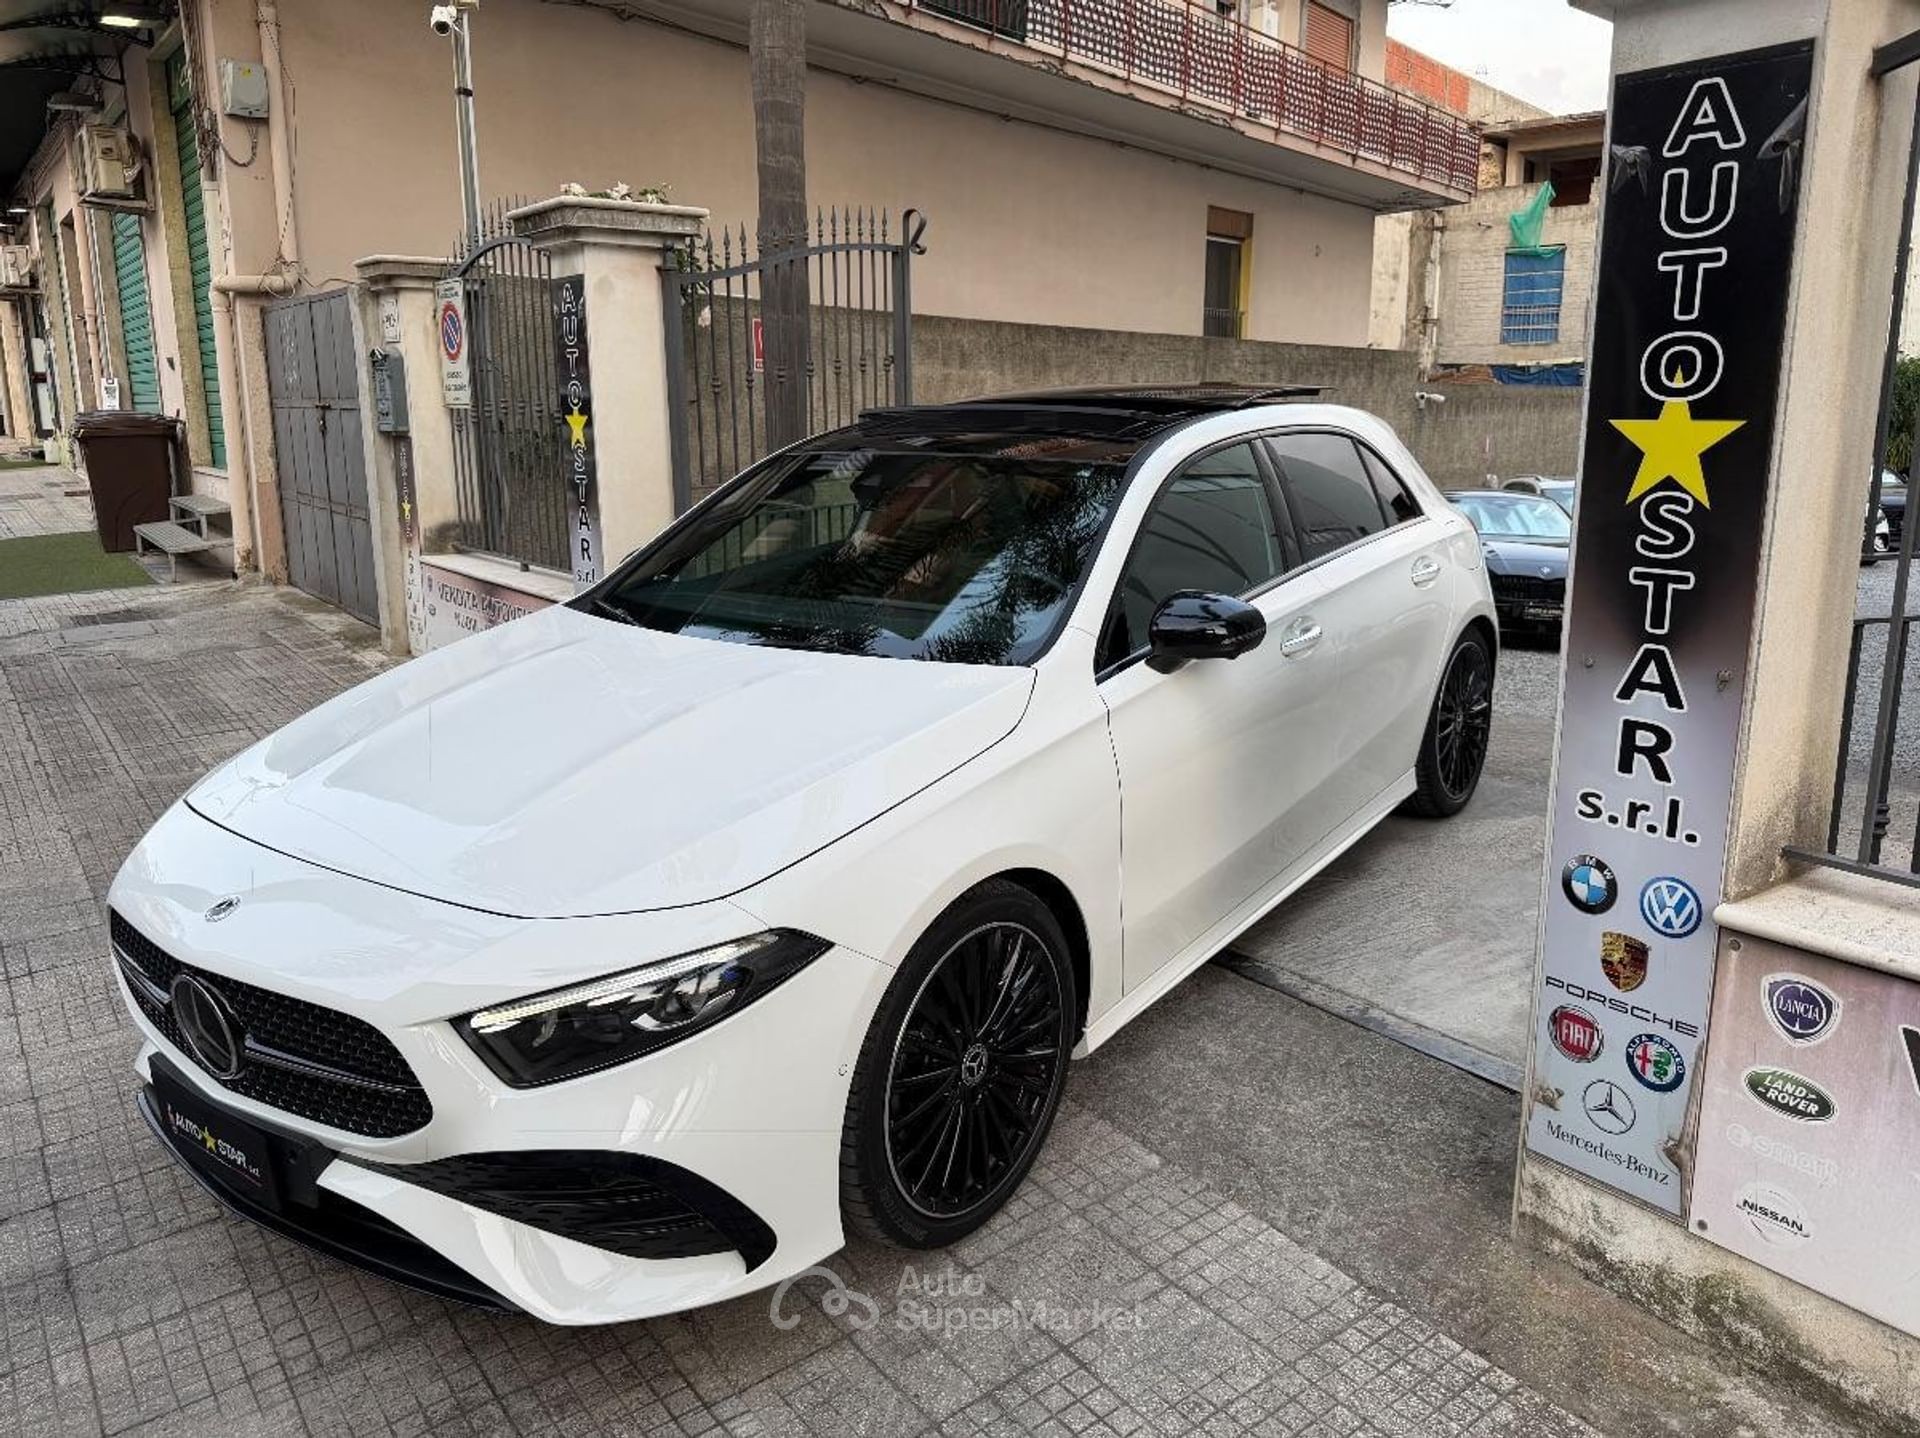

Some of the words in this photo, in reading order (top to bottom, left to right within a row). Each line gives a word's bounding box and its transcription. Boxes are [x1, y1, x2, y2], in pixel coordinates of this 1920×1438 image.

[1639, 76, 1747, 402] AUTO
[561, 283, 582, 410] AUTO
[574, 443, 592, 563] STAR
[1614, 490, 1696, 785] STAR
[1577, 790, 1700, 844] s.r.l.
[1567, 855, 1614, 880] BMW
[1546, 976, 1699, 1038] PORSCHE
[1779, 993, 1821, 1022] LANCIA
[1561, 1018, 1593, 1050] FIAT
[1628, 1034, 1651, 1054] ALFA
[1763, 1075, 1806, 1098] LAND
[1765, 1088, 1820, 1116] ROVER
[175, 1111, 203, 1141] AUTO
[217, 1139, 248, 1169] STAR
[1546, 1119, 1670, 1186] Mercedes-Benz
[1741, 1199, 1804, 1233] NISSAN
